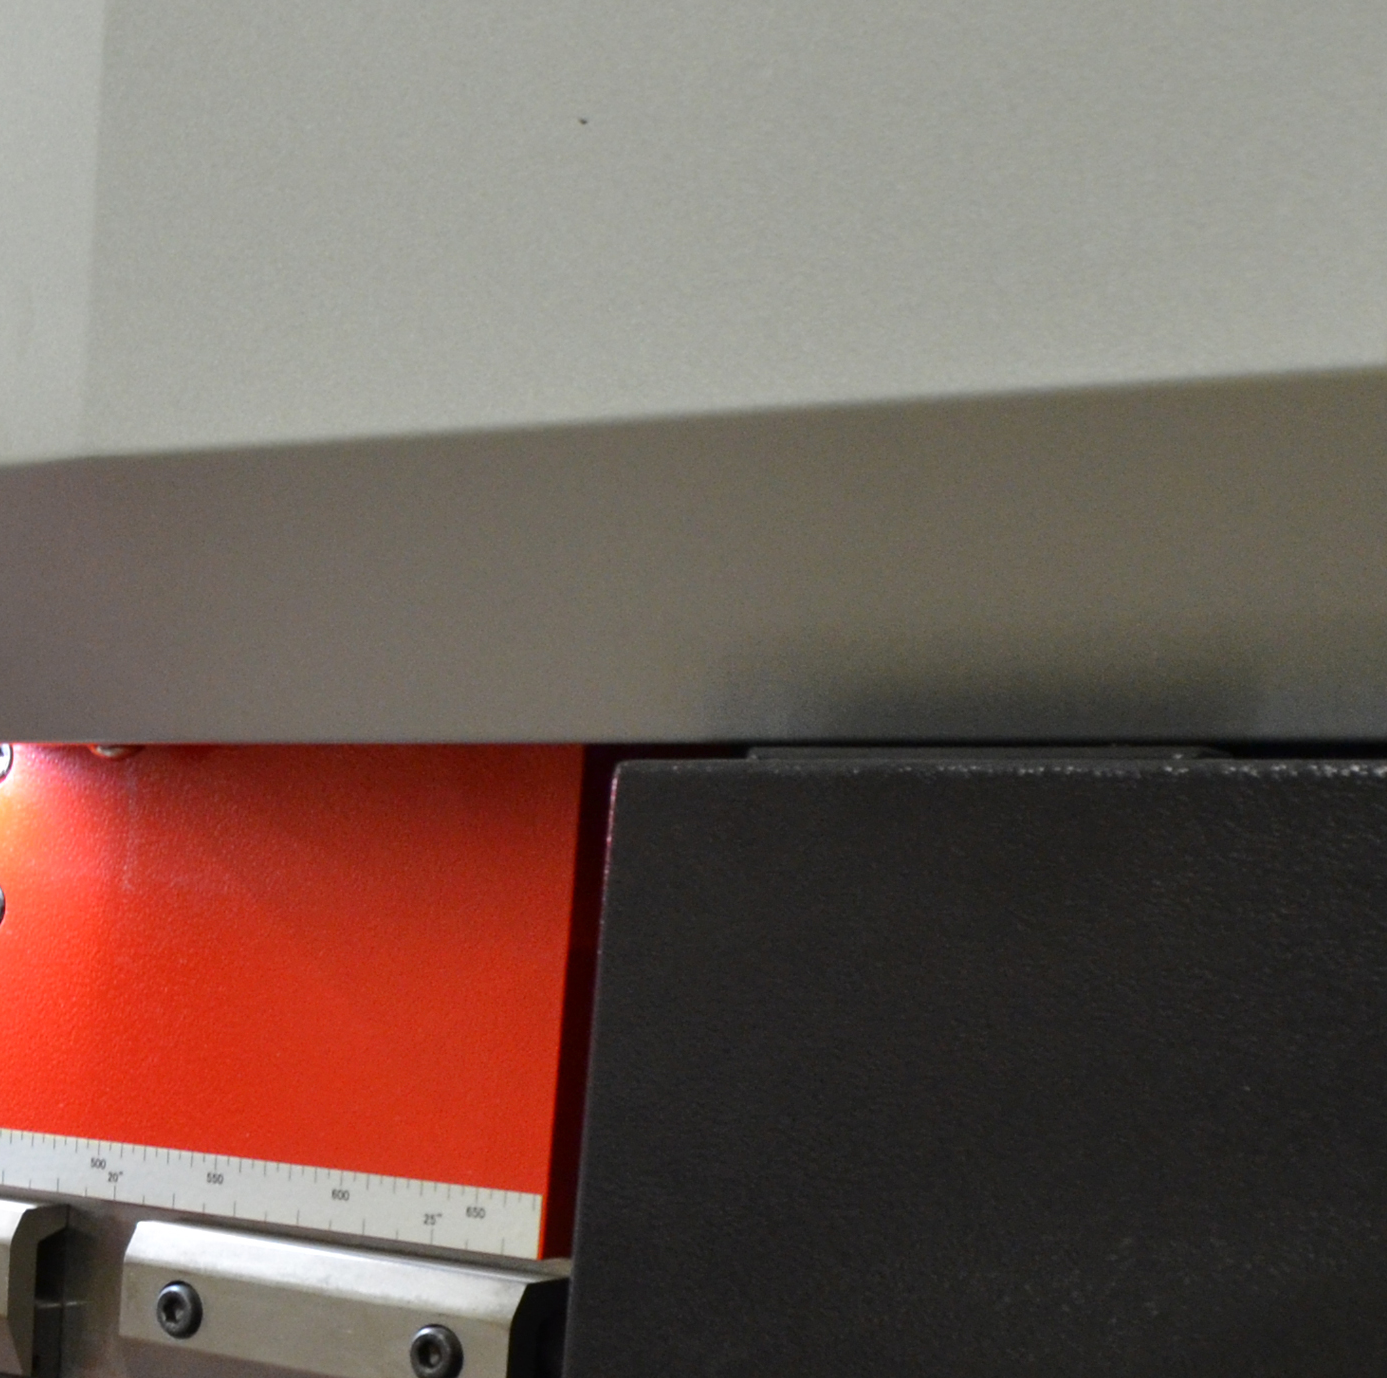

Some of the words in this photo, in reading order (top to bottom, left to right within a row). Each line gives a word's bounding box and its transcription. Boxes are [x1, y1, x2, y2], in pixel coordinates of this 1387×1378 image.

[90, 1157, 106, 1170] 500
[107, 1171, 123, 1183] 20"
[206, 1173, 224, 1185] 550
[331, 1188, 350, 1202] 600
[423, 1213, 443, 1226] 25"
[465, 1206, 486, 1220] 650
